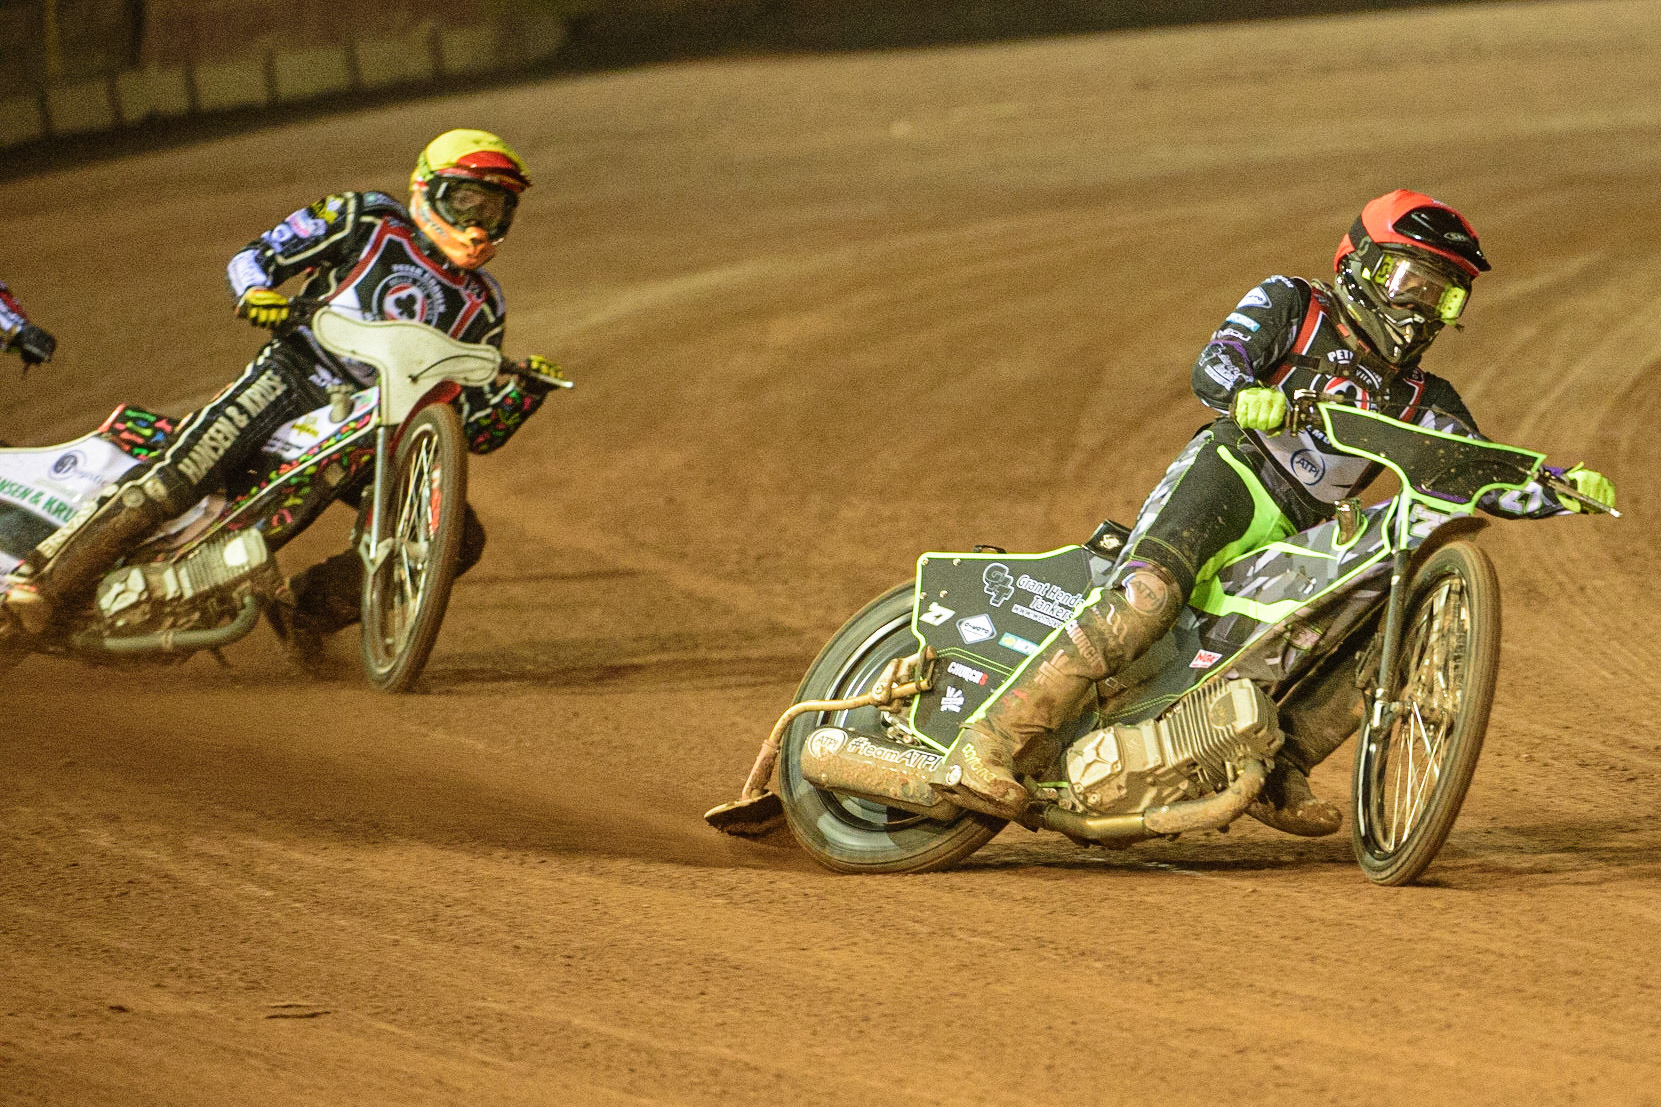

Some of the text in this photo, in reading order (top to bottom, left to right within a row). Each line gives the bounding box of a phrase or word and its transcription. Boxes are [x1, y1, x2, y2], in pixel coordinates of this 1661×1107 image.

[177, 416, 240, 485] HANSEN
[225, 405, 249, 428] &
[1296, 457, 1320, 479] ATPI
[42, 496, 79, 522] KRU
[1016, 574, 1050, 597] Grant
[1029, 595, 1074, 621] Tankers
